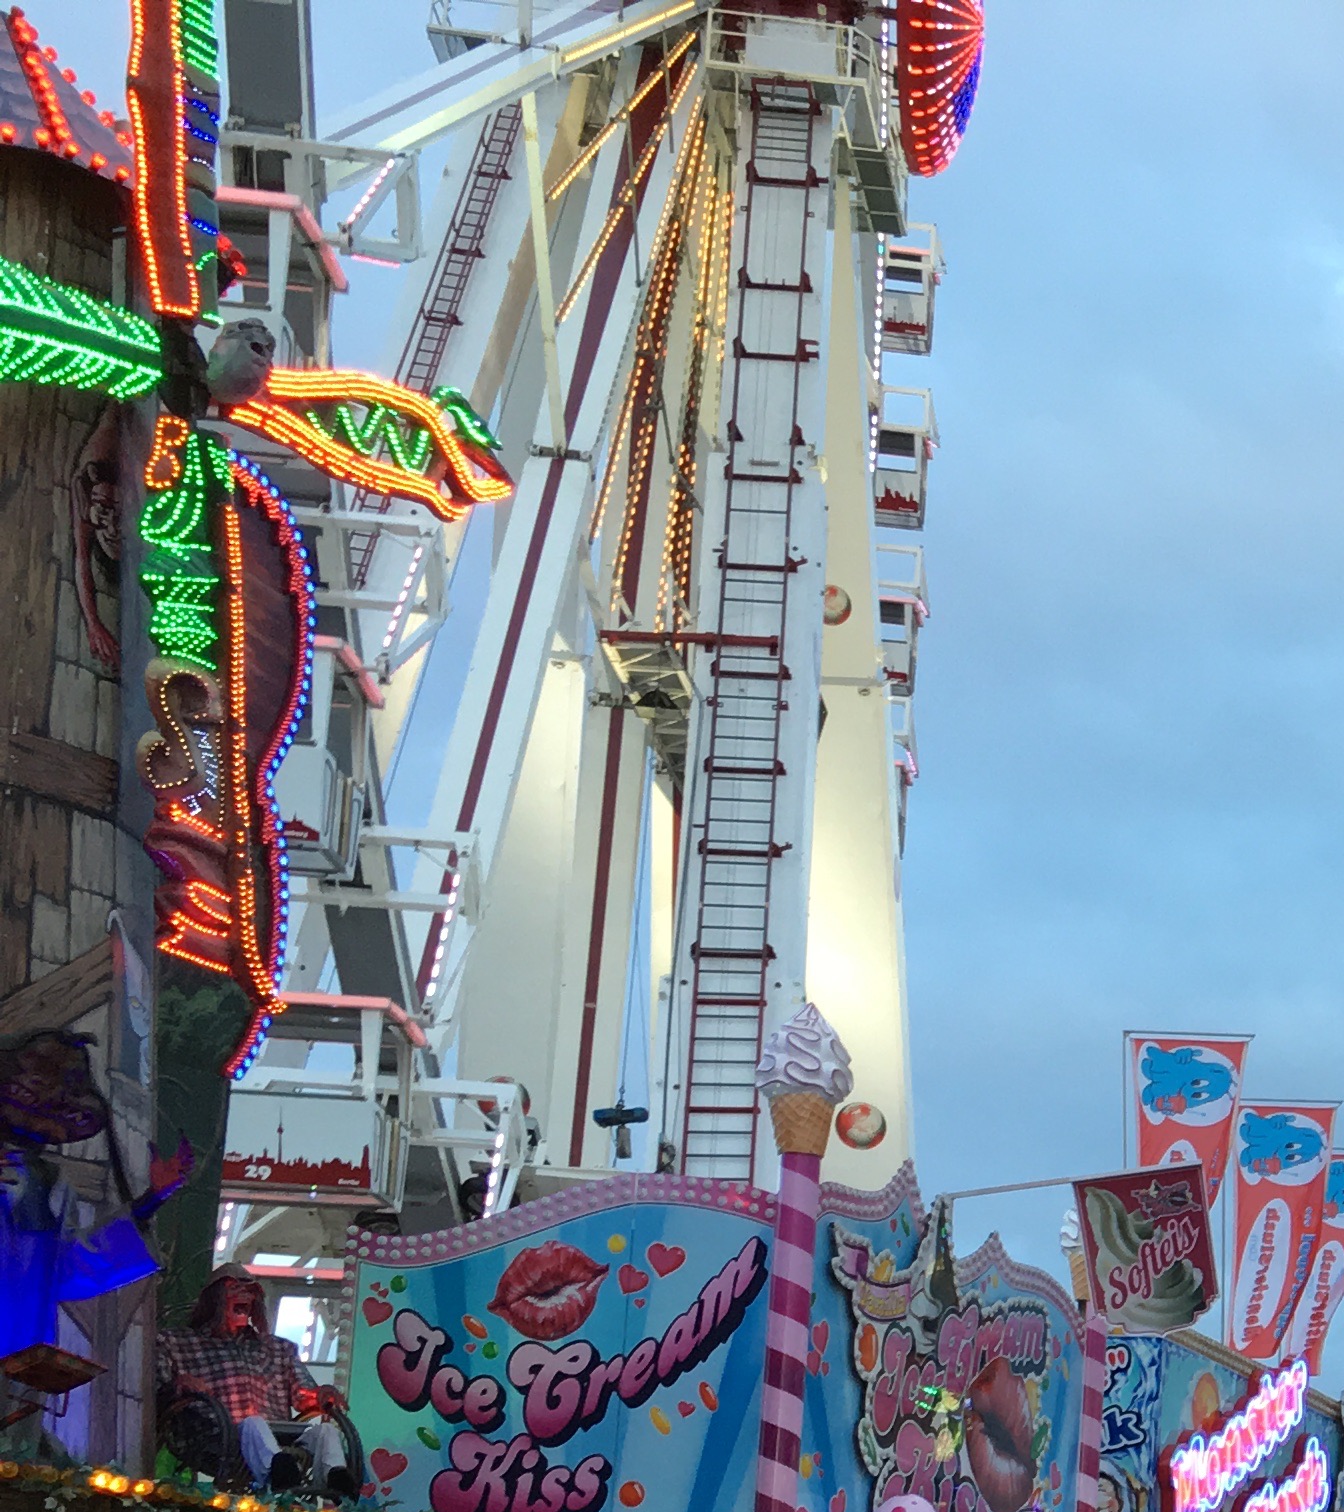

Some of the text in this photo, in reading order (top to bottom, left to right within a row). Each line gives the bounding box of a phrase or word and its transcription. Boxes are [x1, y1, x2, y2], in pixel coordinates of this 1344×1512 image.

[244, 1165, 272, 1181] 29
[1107, 1213, 1199, 1307] Softeis
[376, 1237, 768, 1447] Ice Cream
